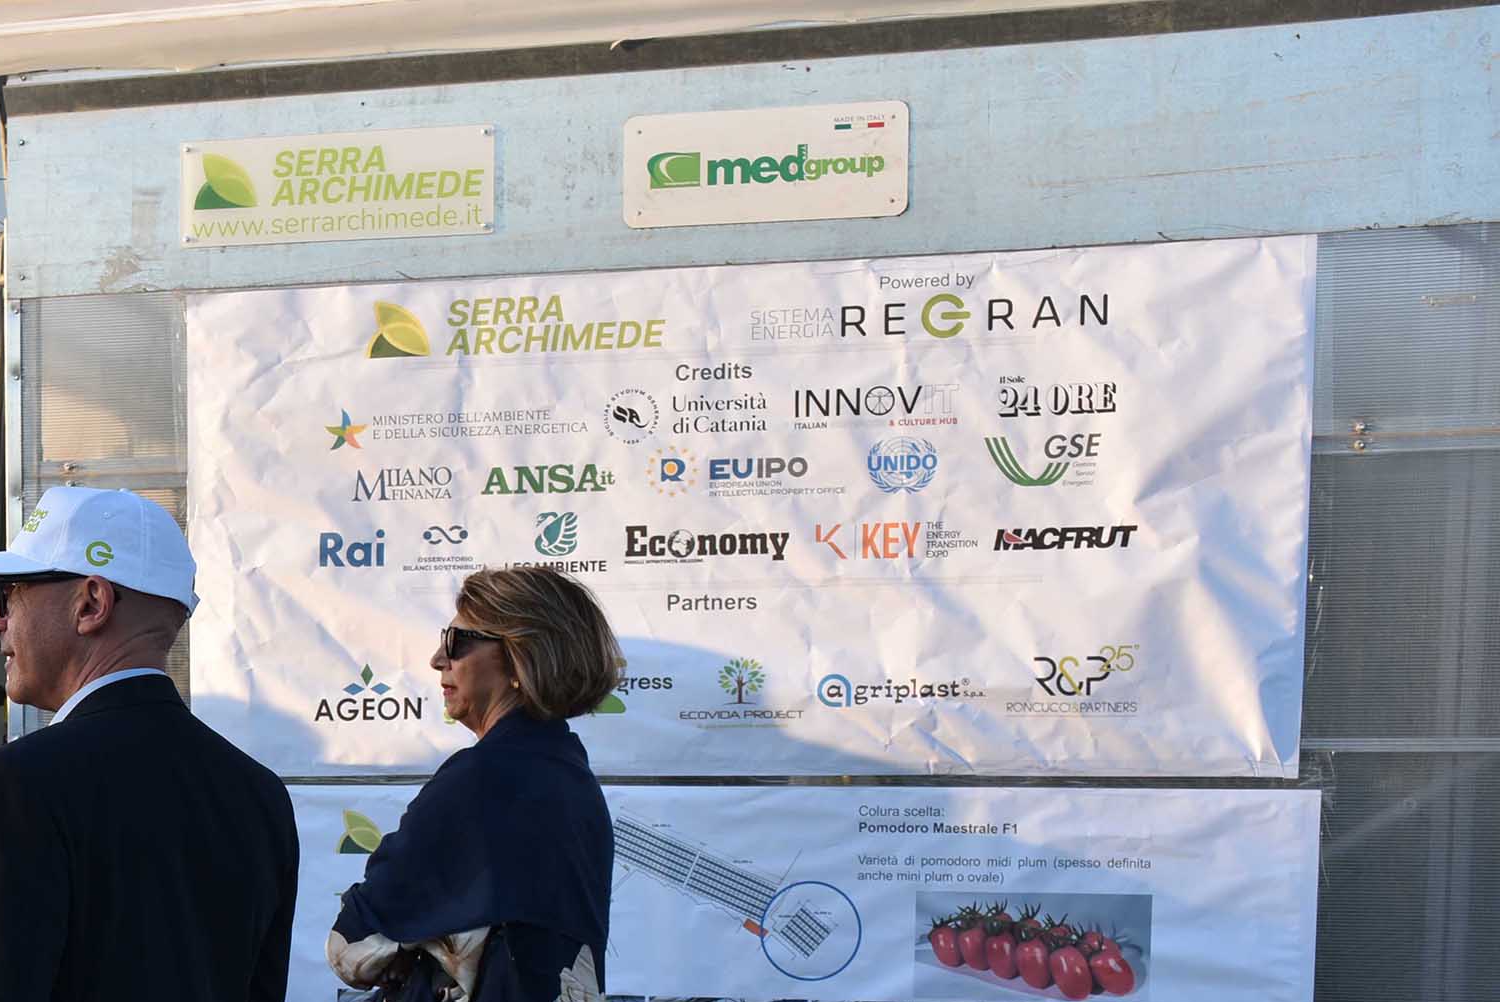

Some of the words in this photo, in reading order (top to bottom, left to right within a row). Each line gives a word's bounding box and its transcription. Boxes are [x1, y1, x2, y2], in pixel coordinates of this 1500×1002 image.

[272, 145, 386, 178] SERRA
[707, 144, 885, 186] medgroup
[271, 169, 485, 207] ARCHIMEDE
[192, 204, 483, 238] www.serrarchimede.it
[879, 273, 950, 289] Powered
[956, 273, 975, 289] by
[447, 295, 565, 327] SERRA
[749, 307, 835, 325] SISTEMA
[840, 293, 1109, 339] REGRAN
[446, 319, 667, 355] ARCHIMEDE
[750, 323, 835, 341] ENERGIA
[675, 363, 753, 381] Credits
[1007, 376, 1026, 384] Sole
[672, 392, 768, 413] Università
[998, 386, 1042, 417] 24
[1046, 381, 1116, 416] ORE
[372, 413, 444, 426] MINISTERO
[448, 409, 551, 424] DELL'AMBIENTE
[673, 417, 690, 434] di
[694, 415, 767, 433] Catania
[794, 421, 828, 430] ITALIAN
[898, 418, 936, 427] CULTURE
[939, 416, 958, 425] HUB
[372, 429, 379, 440] E
[384, 427, 426, 440] DELLA
[430, 425, 501, 438] SICUREZZA
[505, 421, 589, 436] ENERGETICA
[1043, 433, 1102, 459] GSE
[709, 457, 808, 480] EUIPO
[867, 453, 938, 472] UNIDO
[351, 466, 453, 502] MILANO
[756, 480, 782, 488] UNION
[770, 487, 814, 496] PROPERTY
[816, 486, 846, 494] OFFICE
[391, 488, 453, 501] FINANZA
[927, 521, 943, 529] THE
[625, 525, 790, 560] Economy
[862, 522, 921, 559] KEY
[927, 531, 960, 540] ENERGY
[927, 540, 978, 549] TRANSITION
[993, 525, 1138, 551] MACFRUT
[319, 529, 386, 568] Rai
[927, 549, 948, 558] EXPO
[417, 556, 474, 564] OSSERVATORIO
[667, 594, 757, 611] Partners
[1034, 656, 1111, 696] R&P
[315, 697, 422, 721] AGEON
[679, 710, 741, 720] ECOVIDA
[743, 710, 804, 719] PROJECT
[904, 806, 945, 817] scelta:
[858, 822, 929, 834] Pomodoro
[933, 823, 998, 834] Maestrale
[1002, 824, 1018, 834] F1
[858, 855, 898, 867] Varietà
[904, 856, 915, 867] di
[920, 856, 981, 870] pomodoro
[987, 857, 1012, 868] midi
[1018, 857, 1047, 871] plum
[1053, 858, 1101, 872] (spesso
[1107, 858, 1151, 869] definita
[857, 871, 893, 881] anche
[897, 871, 921, 881] mini
[924, 871, 953, 885] plum
[957, 874, 964, 882] o
[968, 872, 1005, 884] ovale)
